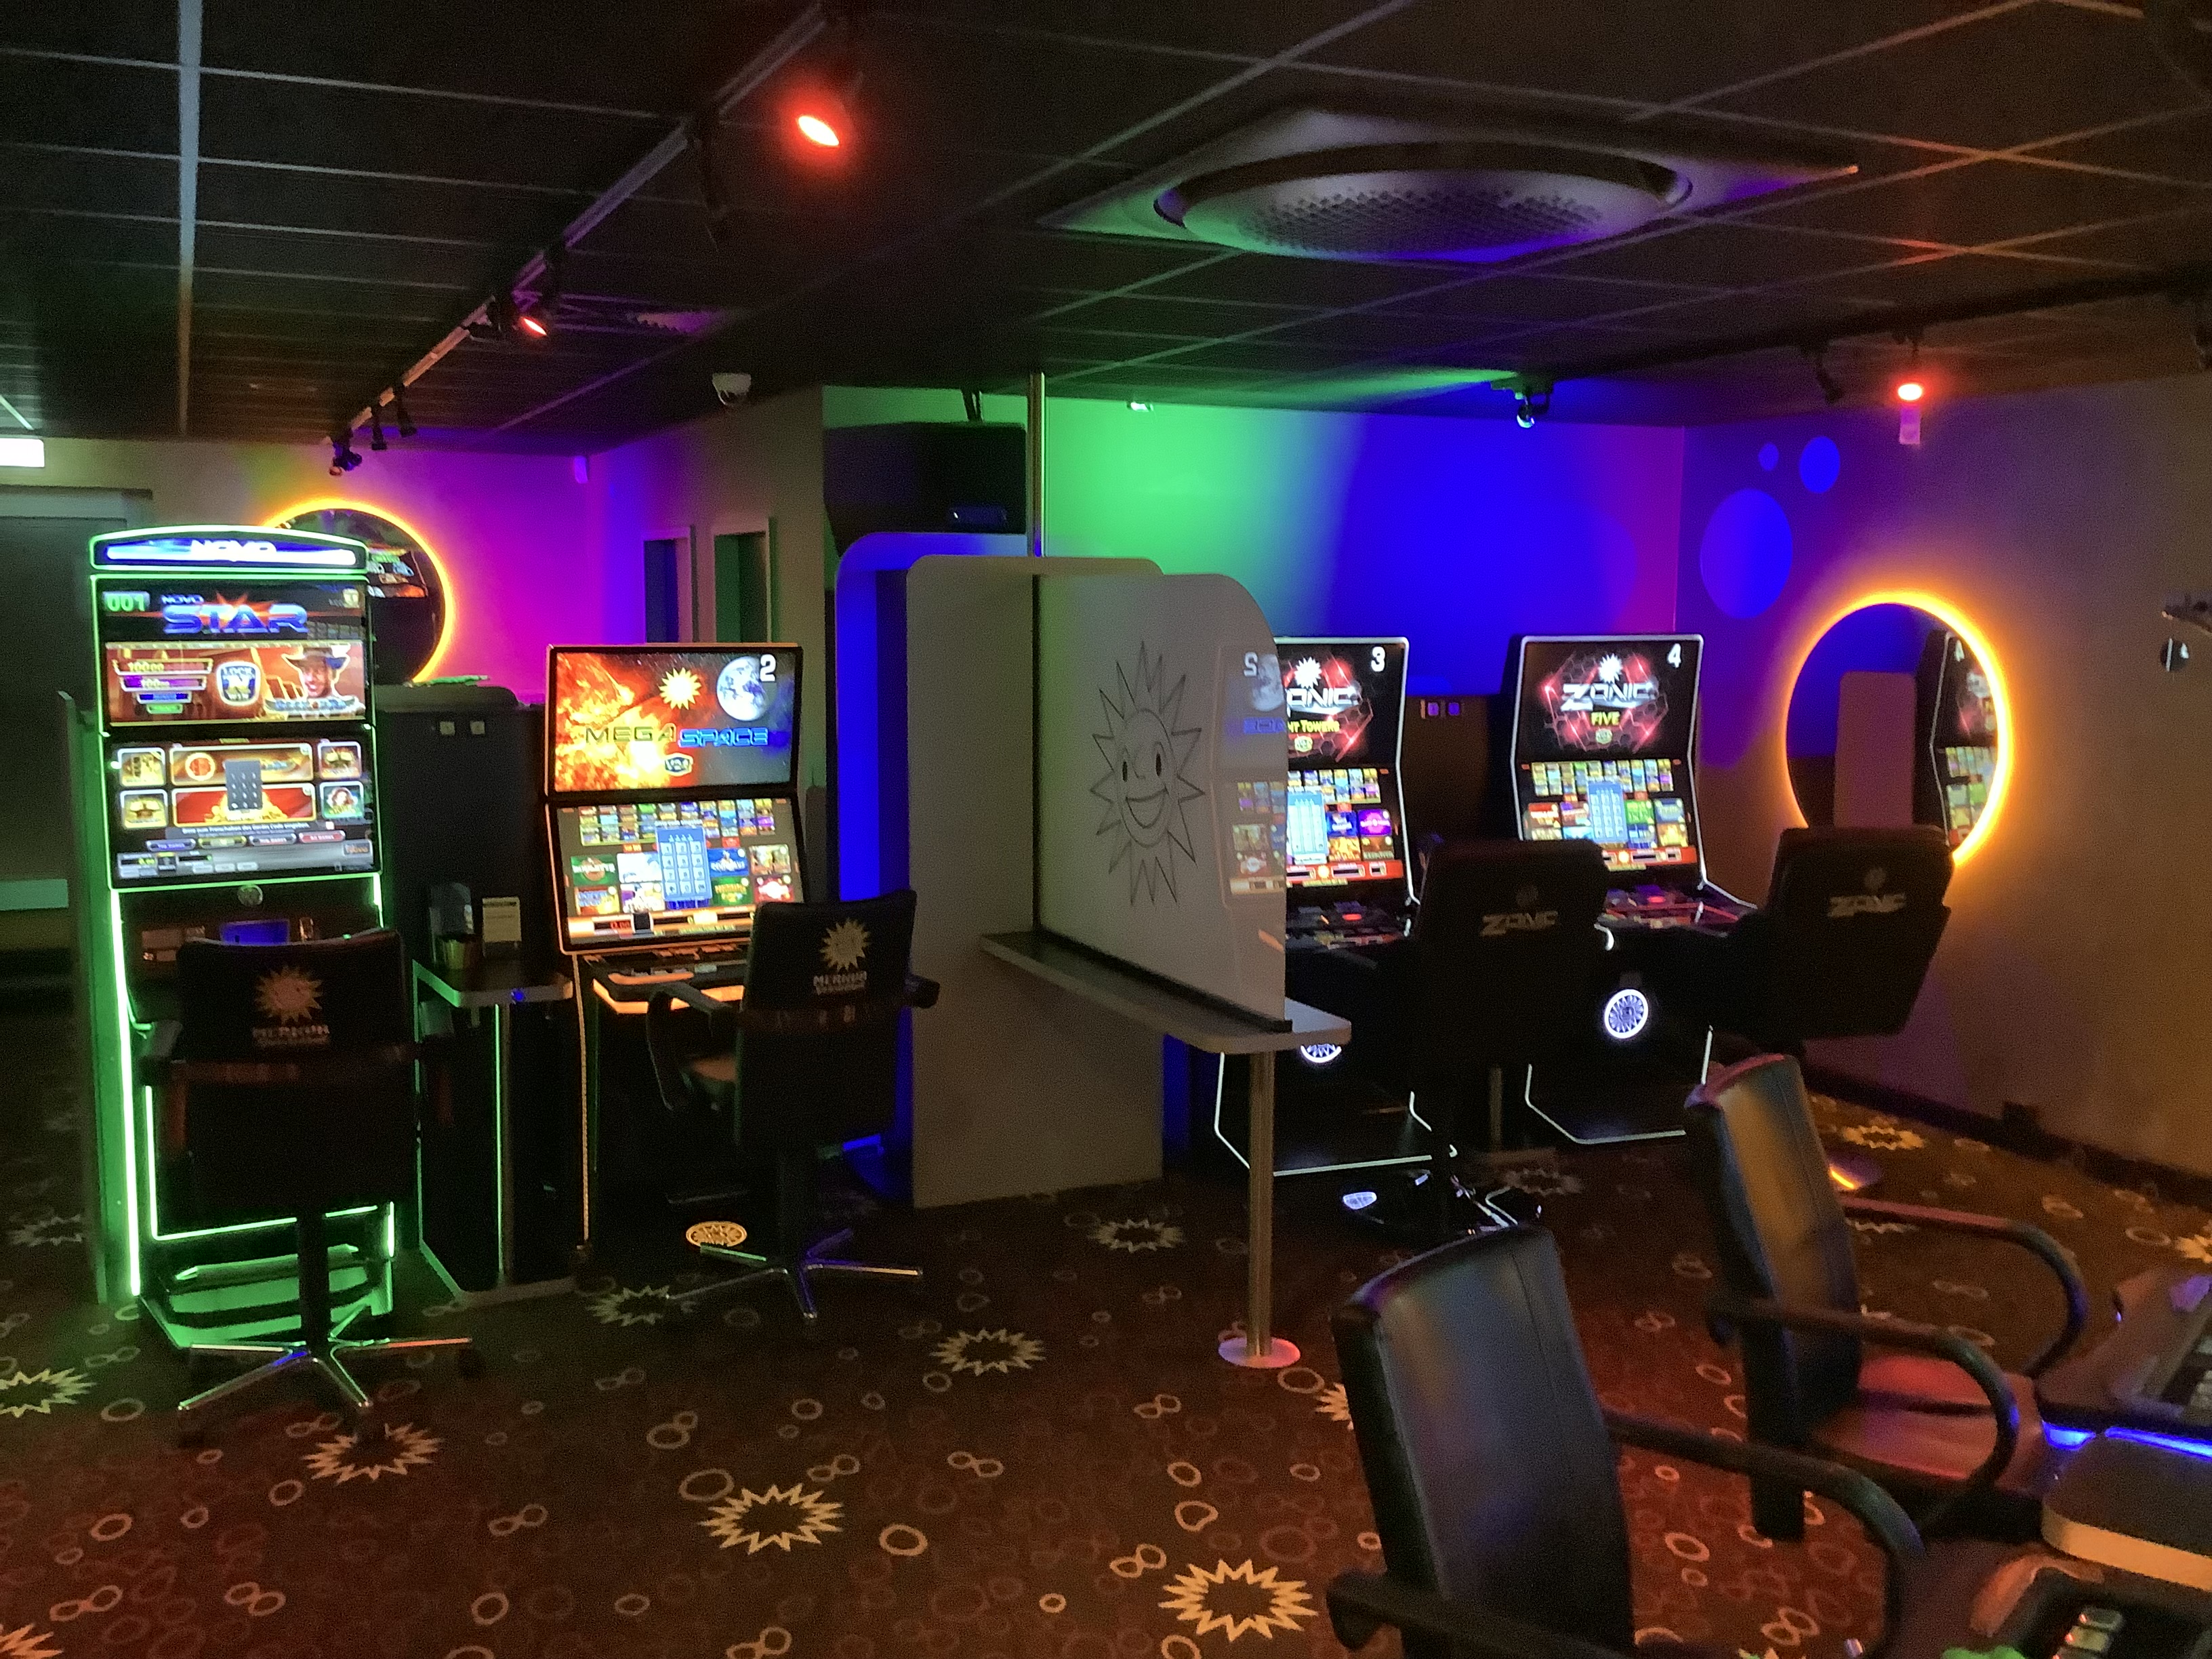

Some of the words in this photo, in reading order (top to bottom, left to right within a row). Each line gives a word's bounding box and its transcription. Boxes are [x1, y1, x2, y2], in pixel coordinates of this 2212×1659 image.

[190, 539, 277, 561] NOVO
[106, 594, 145, 611] 001
[161, 594, 203, 605] NOVO
[163, 604, 309, 634] STAR
[760, 655, 776, 681] 2
[1371, 647, 1386, 672] 3
[1667, 644, 1682, 668] 4
[1286, 687, 1359, 712] ONIC
[1561, 682, 1656, 711] ZONIC
[1591, 712, 1620, 725] FIVE
[586, 723, 676, 743] MEGA
[678, 727, 769, 747] SPACE
